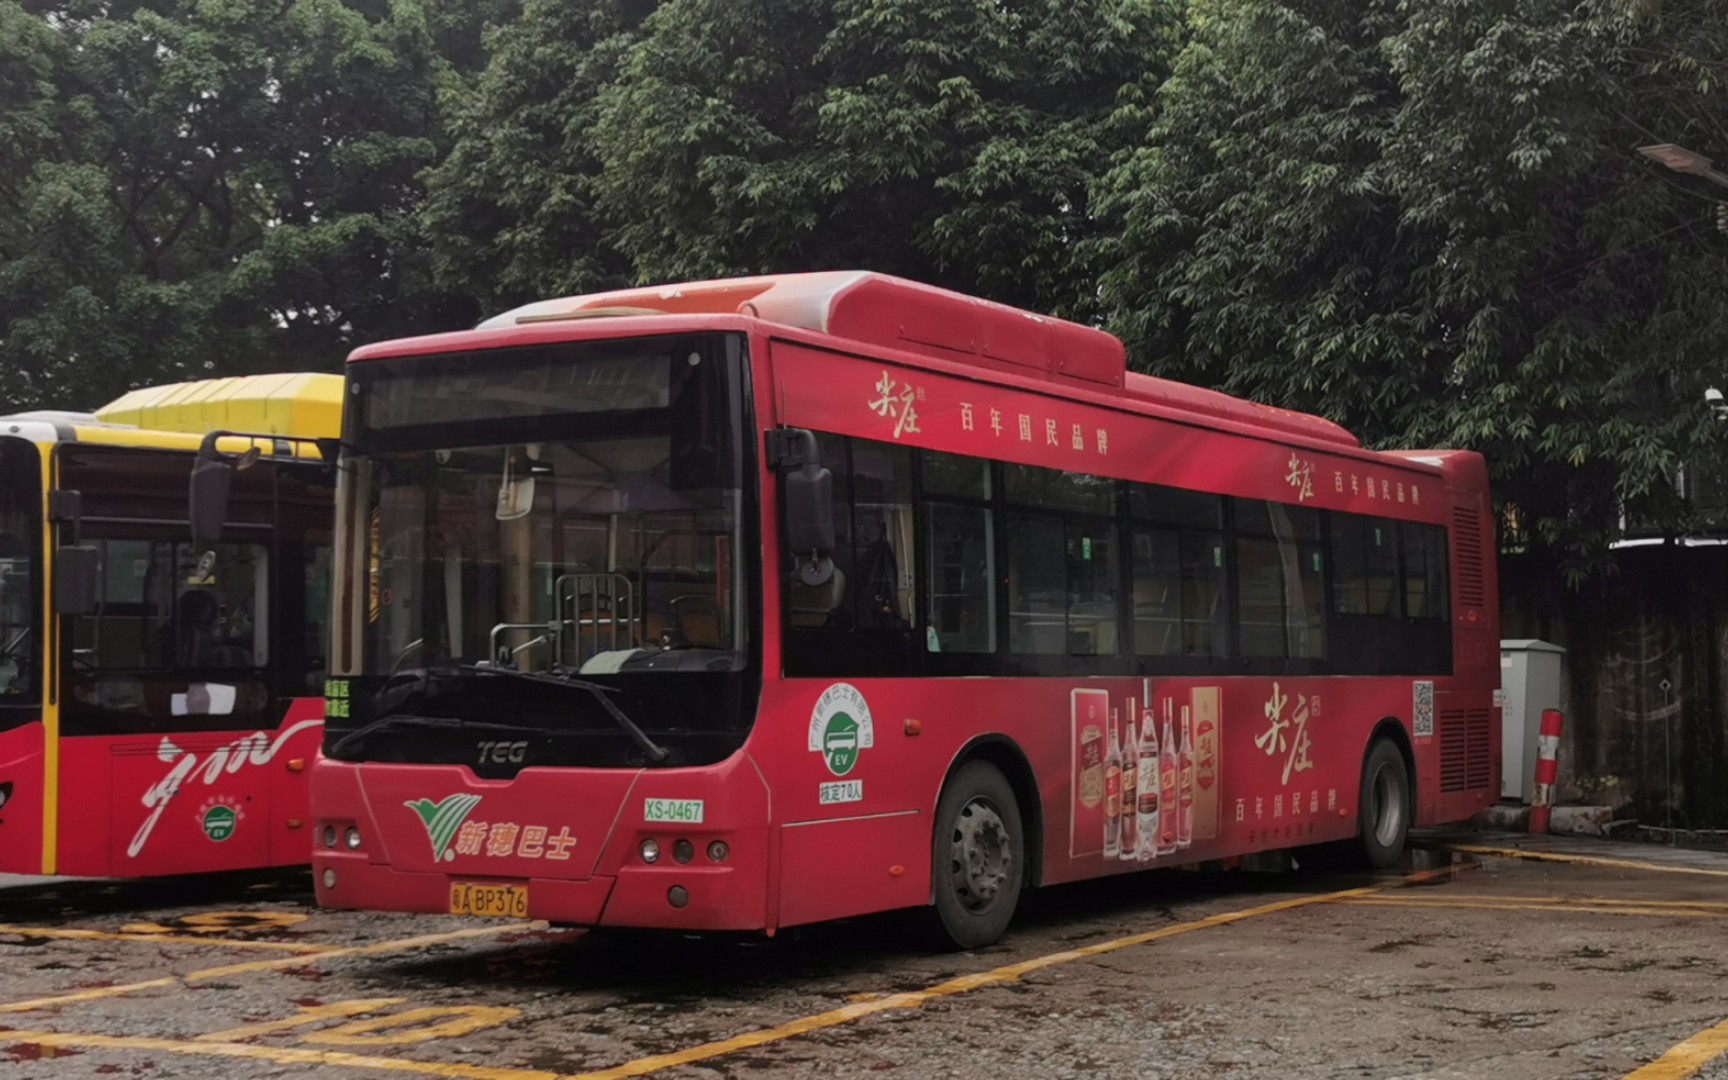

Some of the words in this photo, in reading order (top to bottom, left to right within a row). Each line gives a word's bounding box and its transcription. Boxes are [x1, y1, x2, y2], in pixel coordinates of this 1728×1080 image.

[959, 401, 1109, 456] 百年国民品牌
[835, 753, 849, 766] EV
[645, 799, 702, 822] XS-0467
